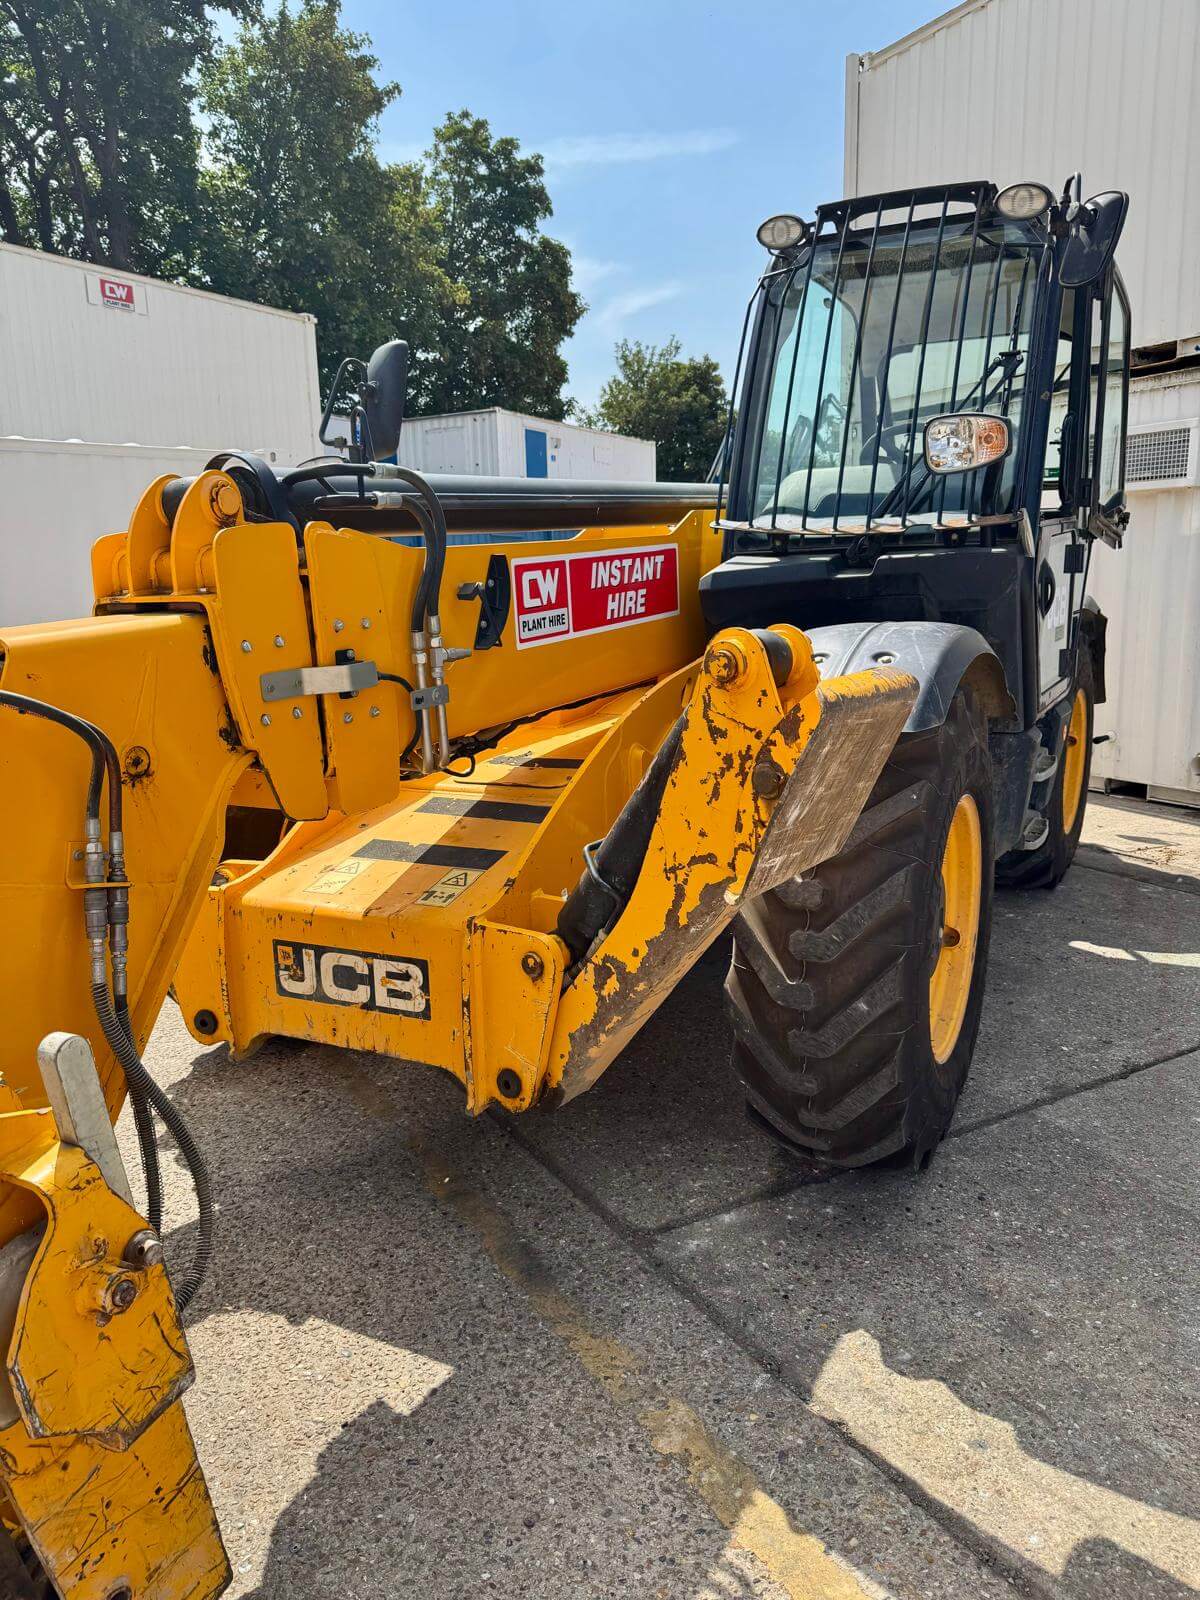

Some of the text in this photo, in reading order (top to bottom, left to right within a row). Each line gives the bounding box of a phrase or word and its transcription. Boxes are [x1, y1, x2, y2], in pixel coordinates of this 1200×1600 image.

[521, 567, 560, 609] CW
[591, 554, 665, 590] INSTANT
[606, 588, 647, 620] HIRE
[522, 613, 566, 633] PLANT HIRE
[279, 948, 426, 1013] JCB
